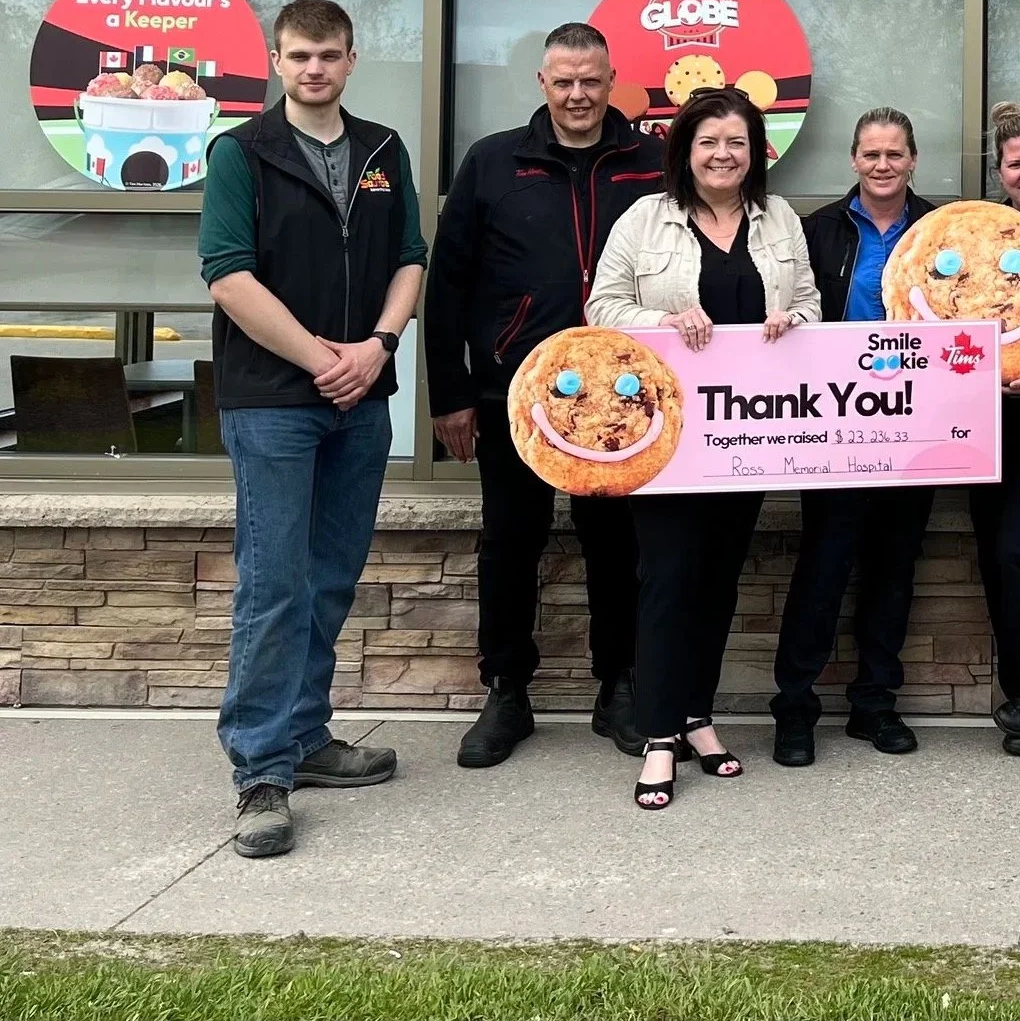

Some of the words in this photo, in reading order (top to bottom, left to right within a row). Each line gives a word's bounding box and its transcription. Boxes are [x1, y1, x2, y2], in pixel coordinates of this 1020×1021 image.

[106, 14, 120, 27] a
[125, 10, 198, 33] Keeper
[867, 332, 923, 351] Smile
[858, 352, 930, 371] Cookie
[945, 345, 982, 366] Tims
[697, 382, 824, 421] Thank
[826, 380, 914, 417] You!
[703, 432, 766, 450] Together
[766, 435, 787, 445] we
[787, 430, 829, 445] raised
[951, 426, 972, 439] for
[731, 456, 765, 477] Ross
[784, 456, 831, 475] Memorial
[847, 455, 893, 473] Hospital
